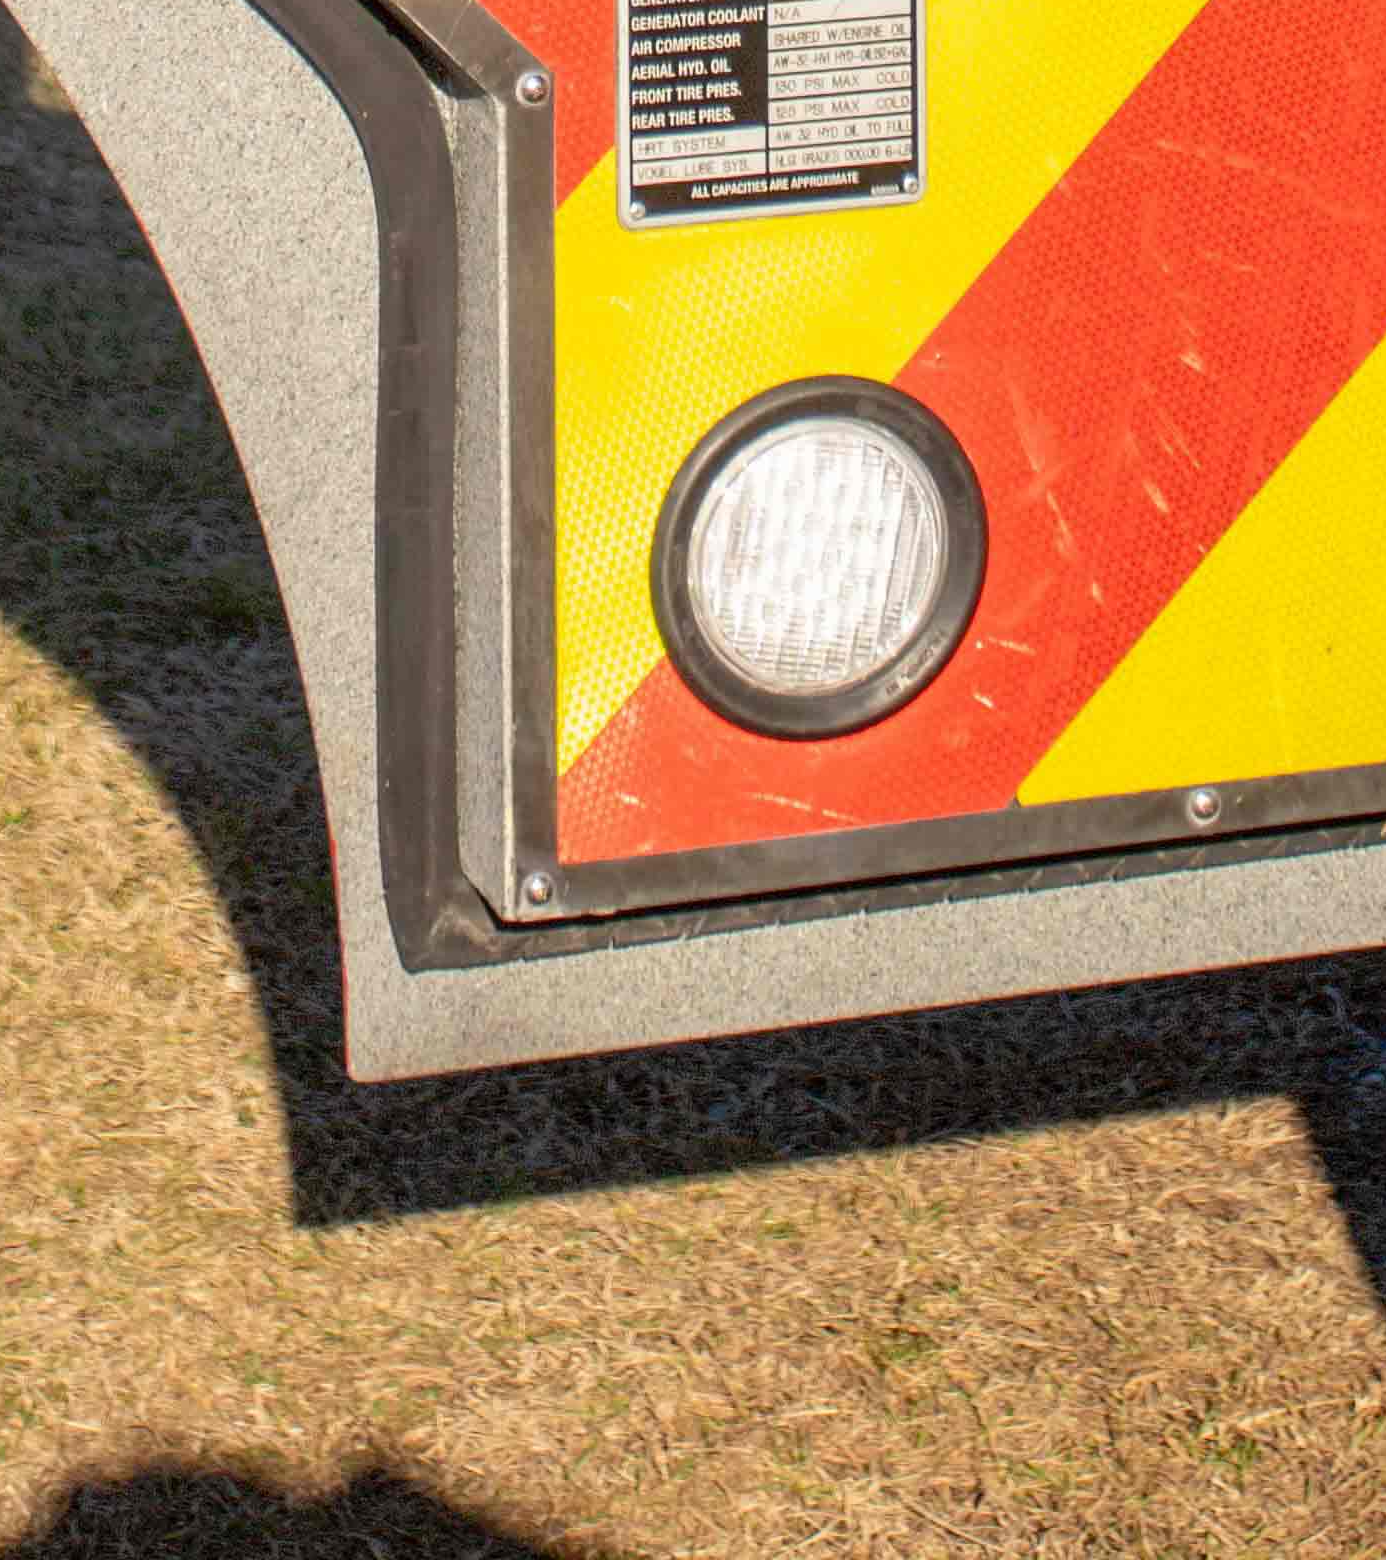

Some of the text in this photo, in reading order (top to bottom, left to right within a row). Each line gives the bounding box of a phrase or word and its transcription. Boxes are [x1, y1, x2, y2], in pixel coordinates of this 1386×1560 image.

[631, 6, 765, 30] GENERATOR COOLANT
[631, 32, 740, 55] AIR COMPRESSOR
[631, 58, 731, 80] AERIAL HYD. OIL
[632, 81, 741, 104] FRONT TIRE PRES.
[632, 106, 735, 128] REAR TIRE PRES.
